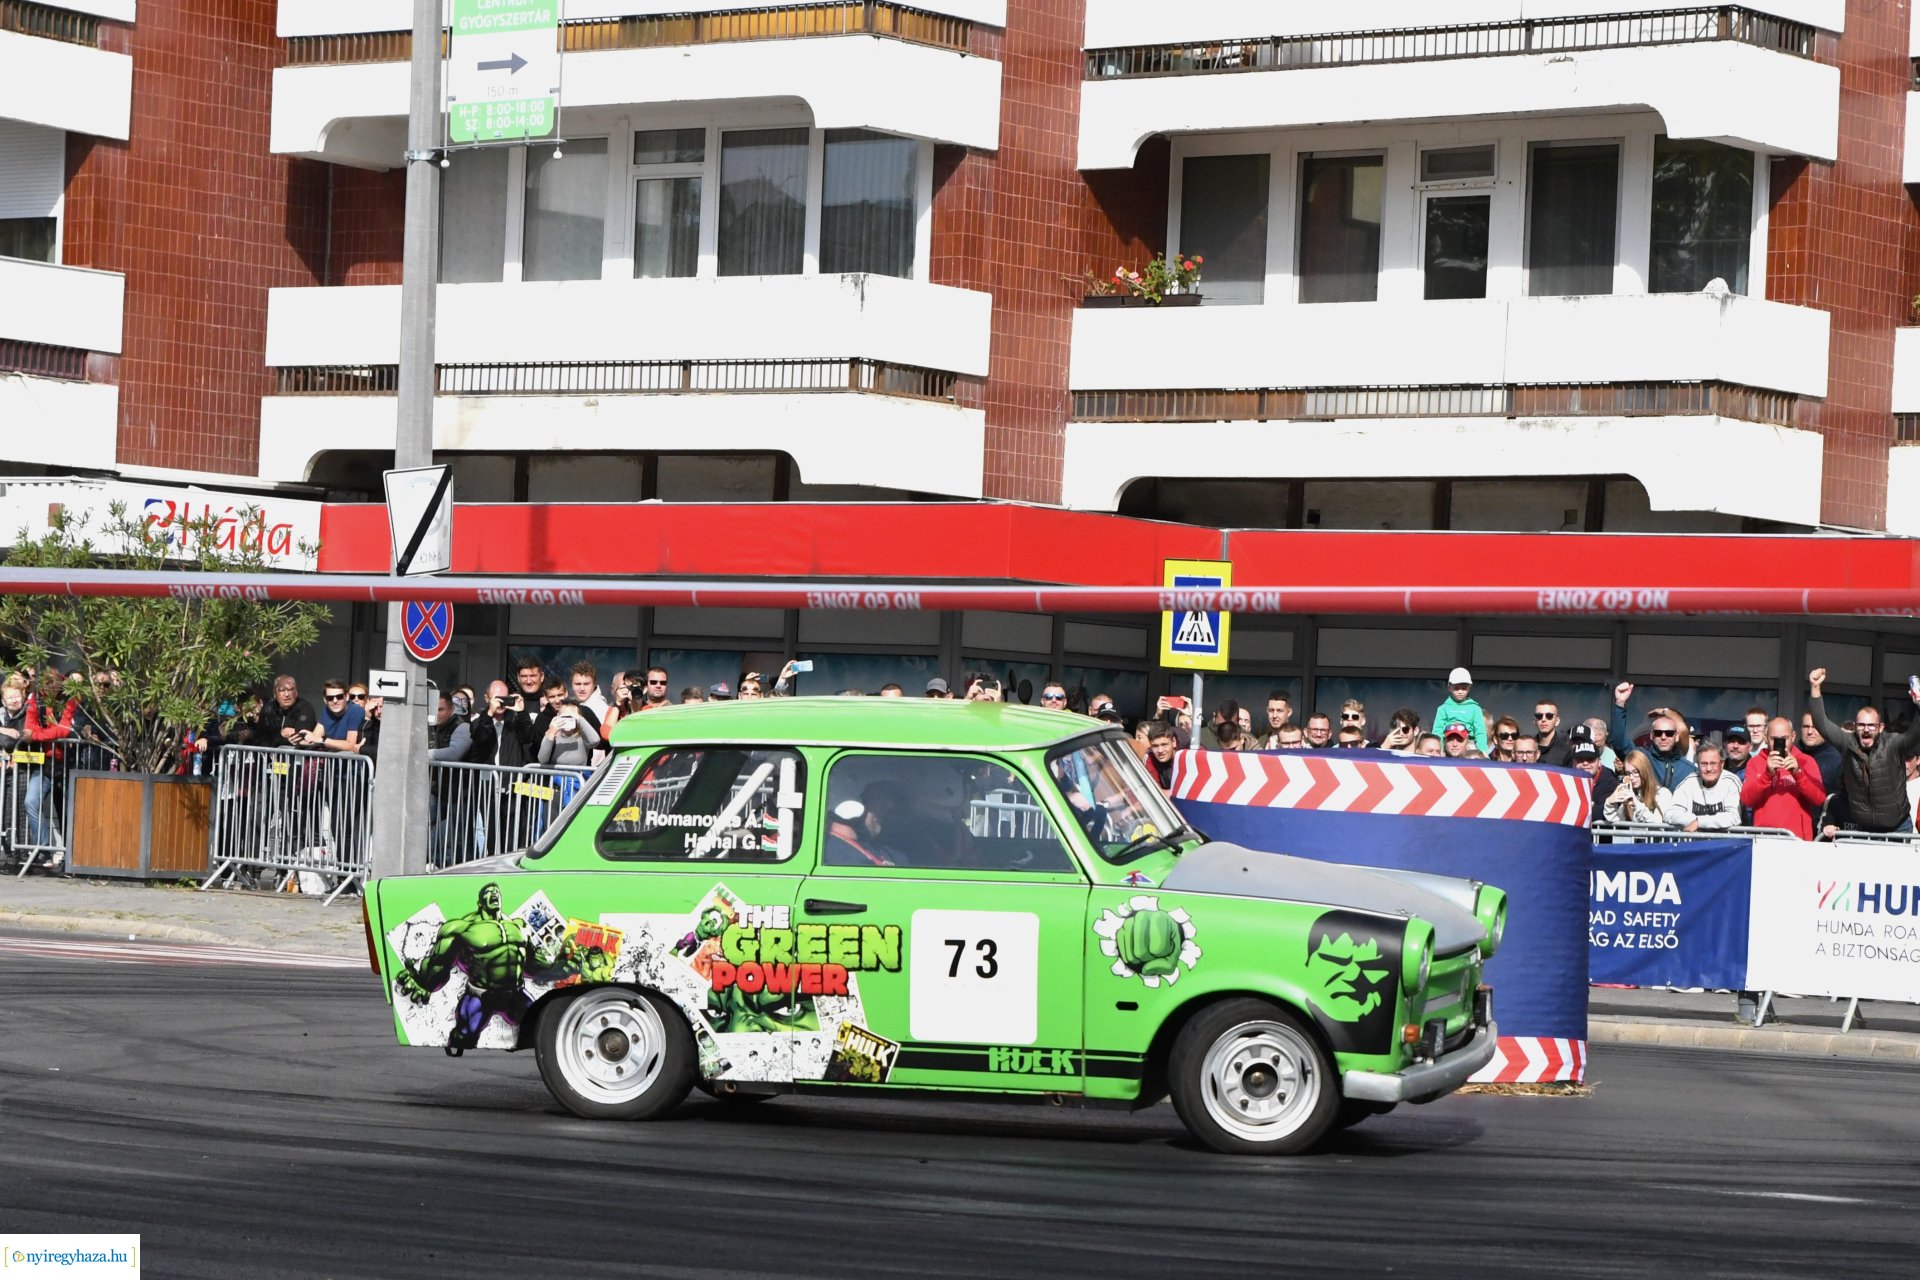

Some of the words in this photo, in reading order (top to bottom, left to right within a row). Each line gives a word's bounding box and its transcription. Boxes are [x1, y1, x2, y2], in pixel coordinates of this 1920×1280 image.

[460, 8, 550, 30] GYÓGYSZERTÁR
[181, 502, 294, 556] Háda
[863, 592, 890, 609] GO
[893, 592, 921, 609] NO
[1158, 591, 1217, 611] ZONE!
[1220, 592, 1247, 611] GO
[1251, 591, 1280, 611] NO
[1536, 589, 1600, 610] ZONE!
[1602, 589, 1633, 609] GO
[1637, 589, 1669, 609] NO
[1575, 742, 1596, 753] LADA
[741, 833, 761, 850] G.
[1589, 870, 1682, 905] MDA
[733, 904, 790, 929] THE
[1623, 911, 1681, 928] SAFETY
[1613, 932, 1636, 949] AZ
[1638, 929, 1680, 949] ELSŐ
[1817, 919, 1875, 938] HUMDA
[1884, 924, 1918, 940] ROA
[575, 926, 620, 955] HULK
[721, 923, 903, 973] GREEN
[944, 938, 999, 979] 73
[1815, 941, 1827, 956] A
[1832, 942, 1920, 963] BIZTONSÁG
[711, 960, 849, 996] POWER
[844, 1030, 897, 1068] HULK
[988, 1047, 1075, 1074] HULK
